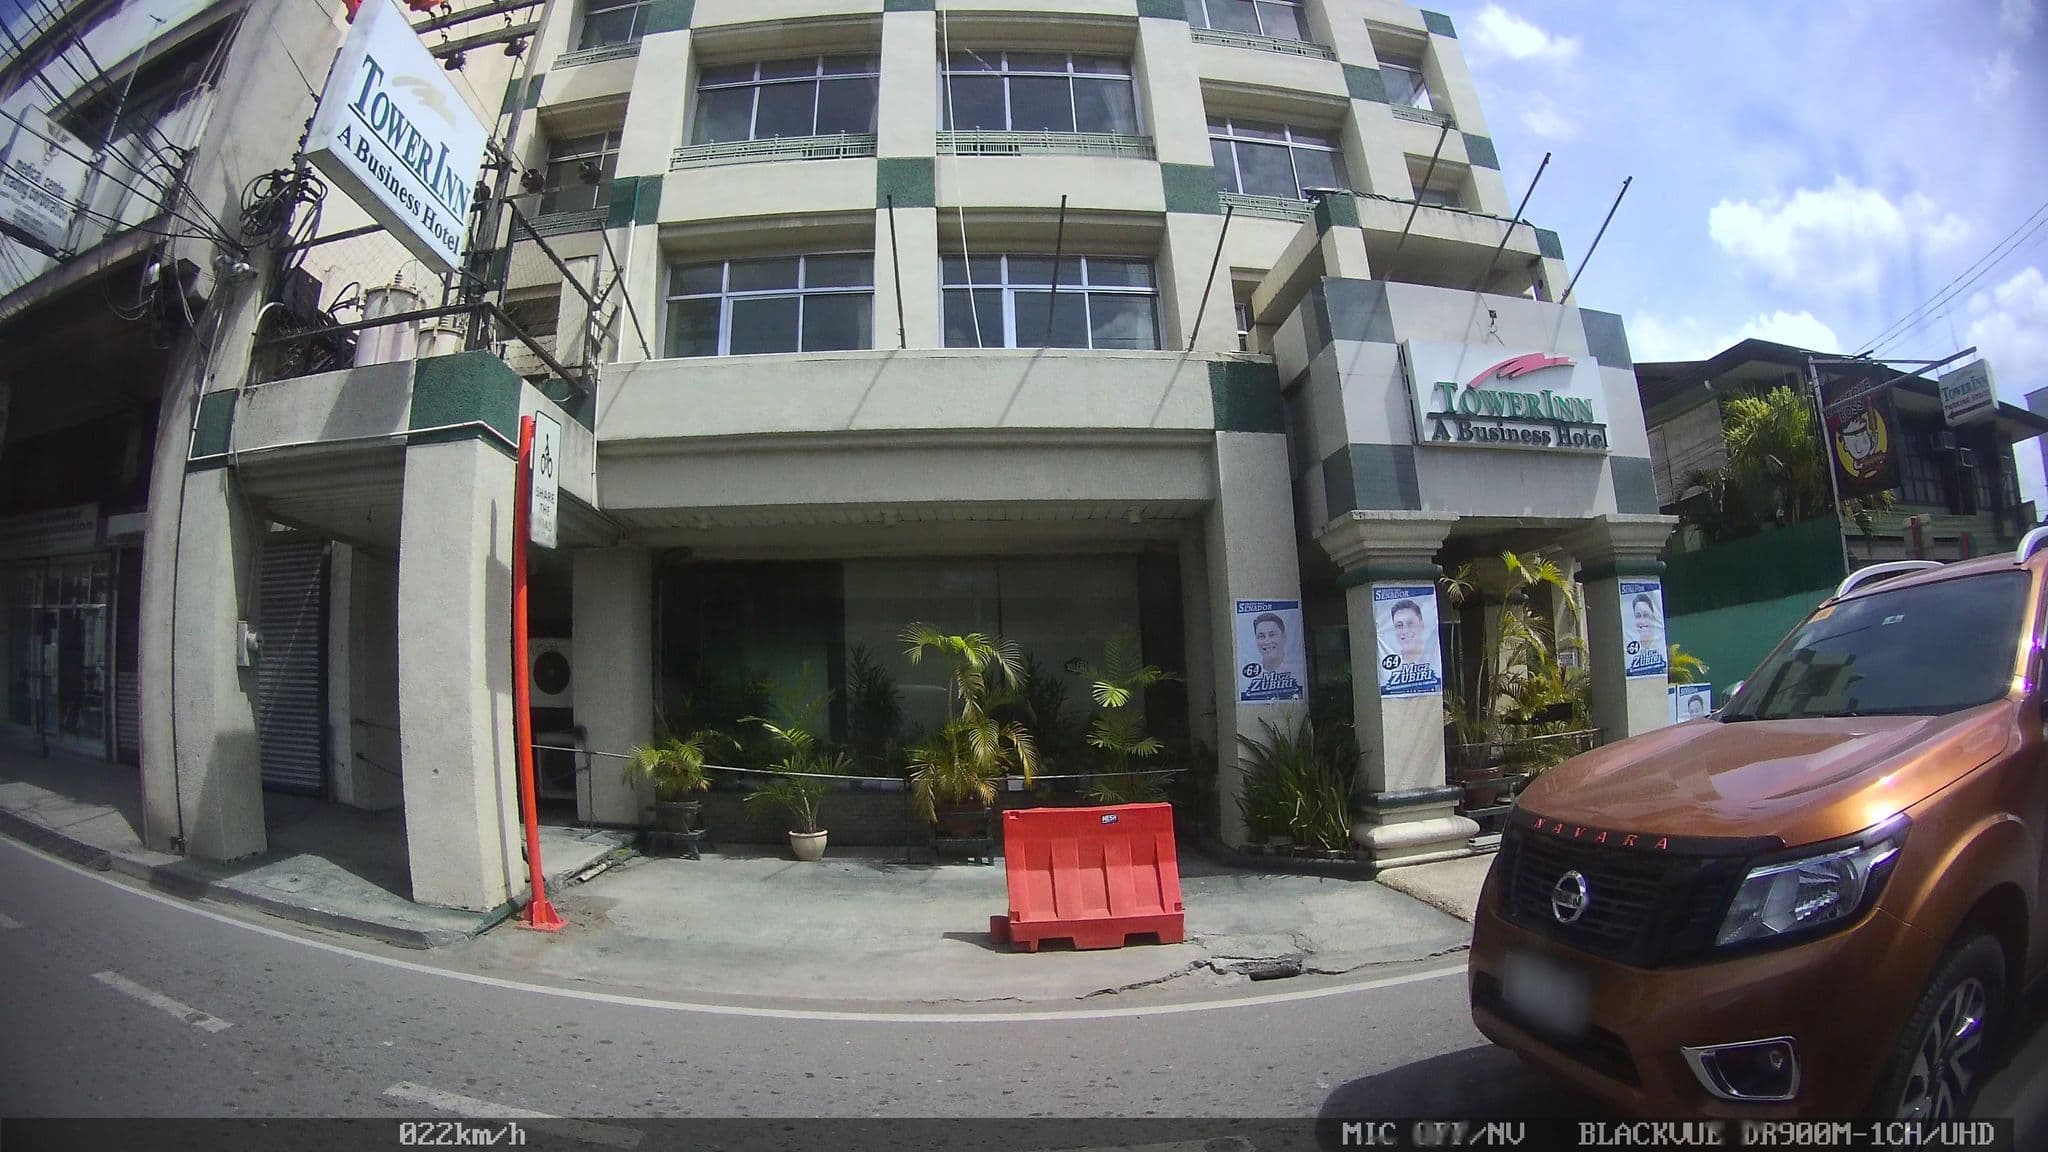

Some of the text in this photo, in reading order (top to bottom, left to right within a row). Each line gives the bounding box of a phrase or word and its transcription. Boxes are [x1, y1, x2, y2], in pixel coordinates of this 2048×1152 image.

[336, 124, 460, 256] A Business Hotel
[1431, 419, 1609, 450] A Business Hotel
[1375, 590, 1410, 600] SENADOR
[1250, 678, 1294, 692] ZUBIRI
[1390, 669, 1433, 685] ZUBIRI
[1533, 818, 1668, 850] NAVARA
